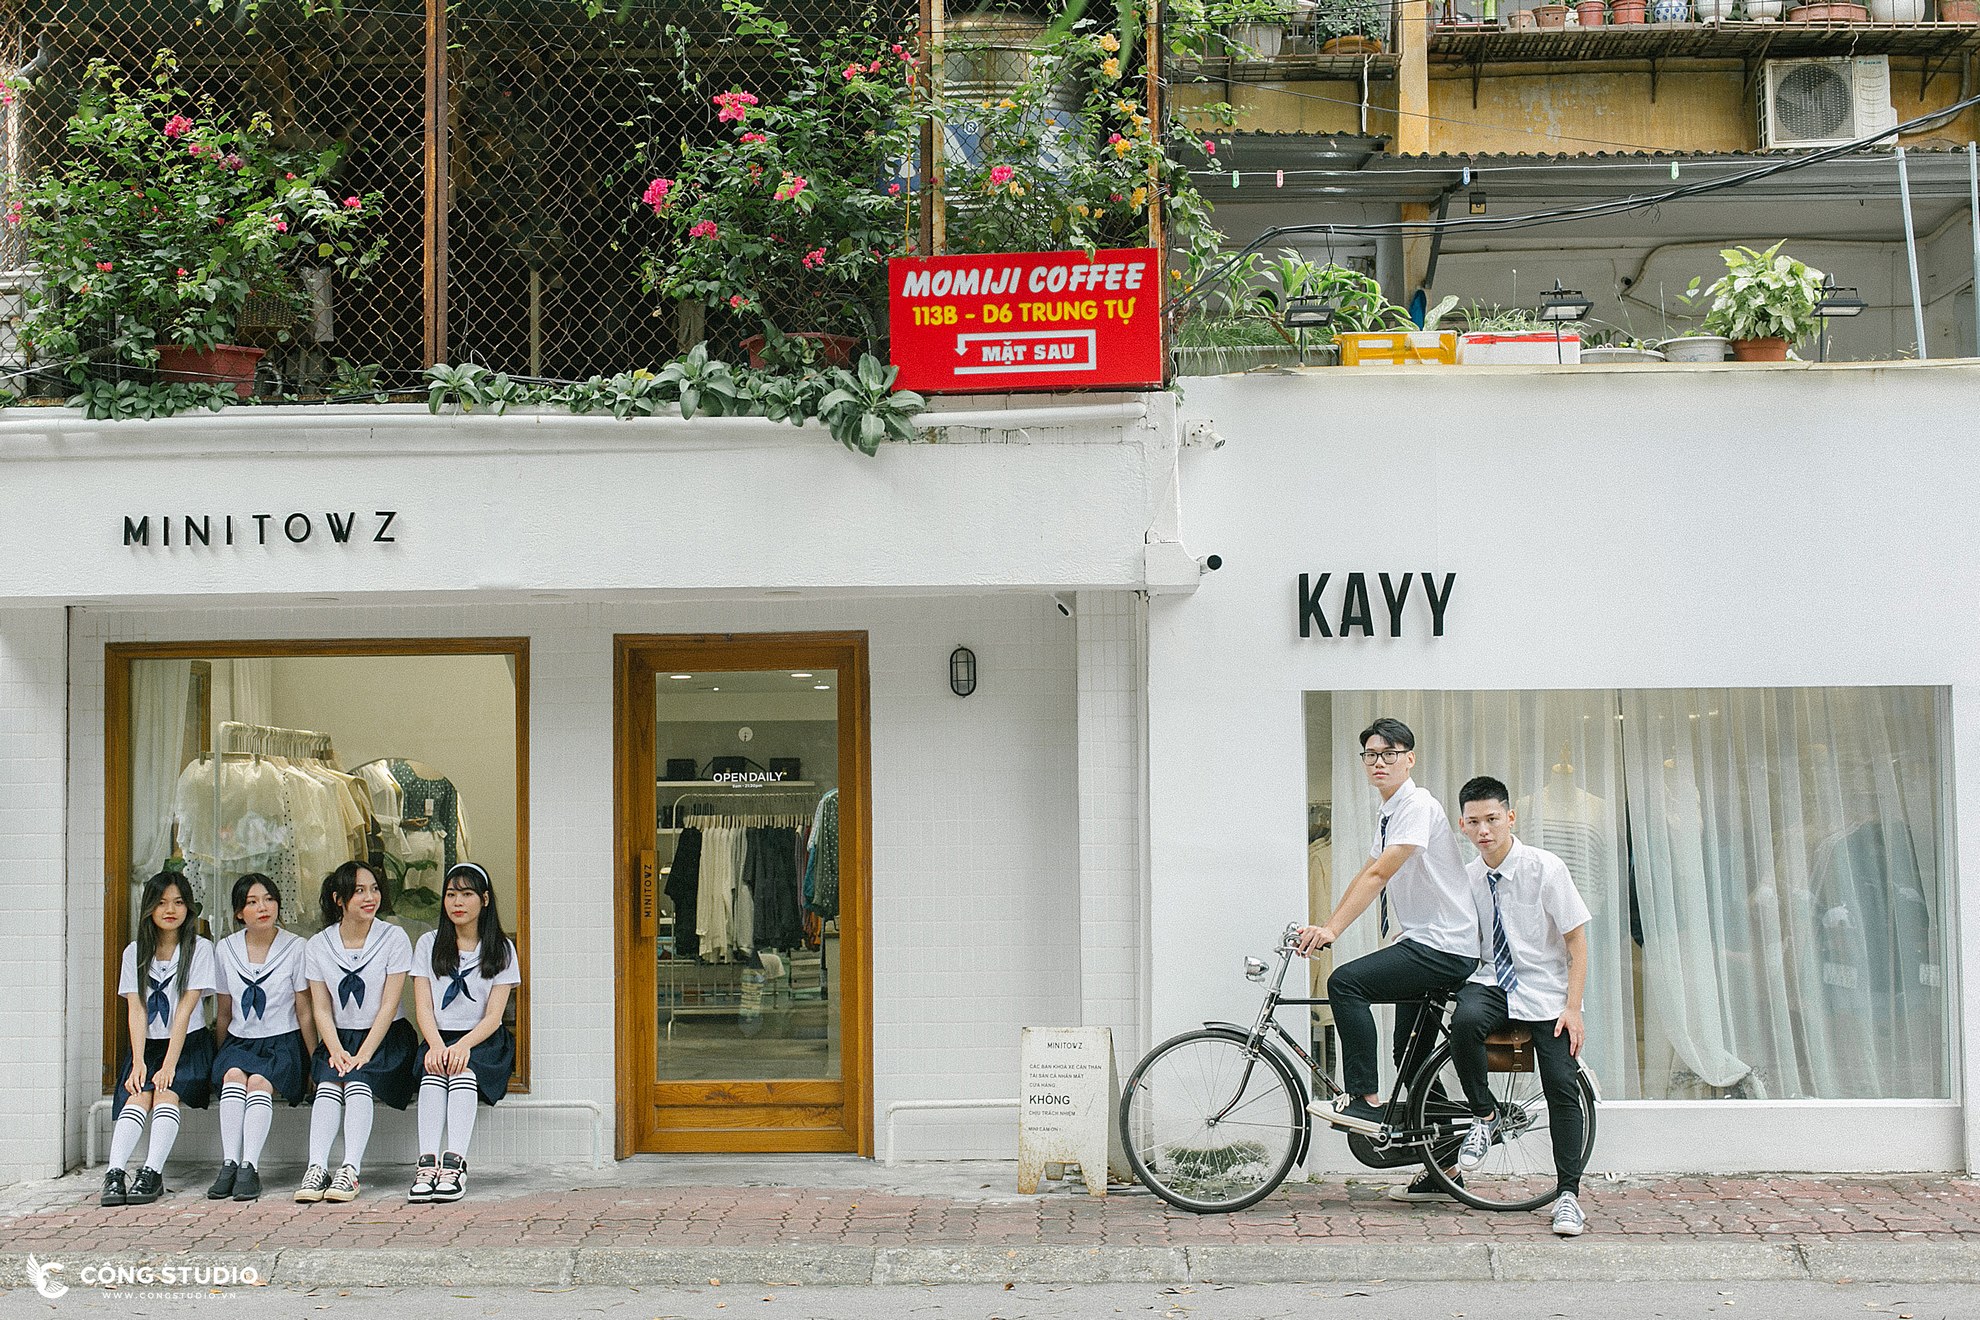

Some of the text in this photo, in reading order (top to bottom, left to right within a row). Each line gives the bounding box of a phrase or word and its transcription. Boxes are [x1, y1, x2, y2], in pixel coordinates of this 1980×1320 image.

[902, 262, 1146, 298] MOMIJI COFFEE
[912, 305, 958, 326] 113B
[983, 304, 1013, 323] D6
[1018, 300, 1098, 322] TRUNG
[1104, 296, 1136, 325] TỰ
[981, 341, 1075, 365] MẶT SAU
[123, 511, 397, 546] MINITOWZ
[1298, 572, 1457, 637] KAYY
[644, 864, 652, 918] MINITOWZ
[1029, 1092, 1070, 1105] KHÔNG
